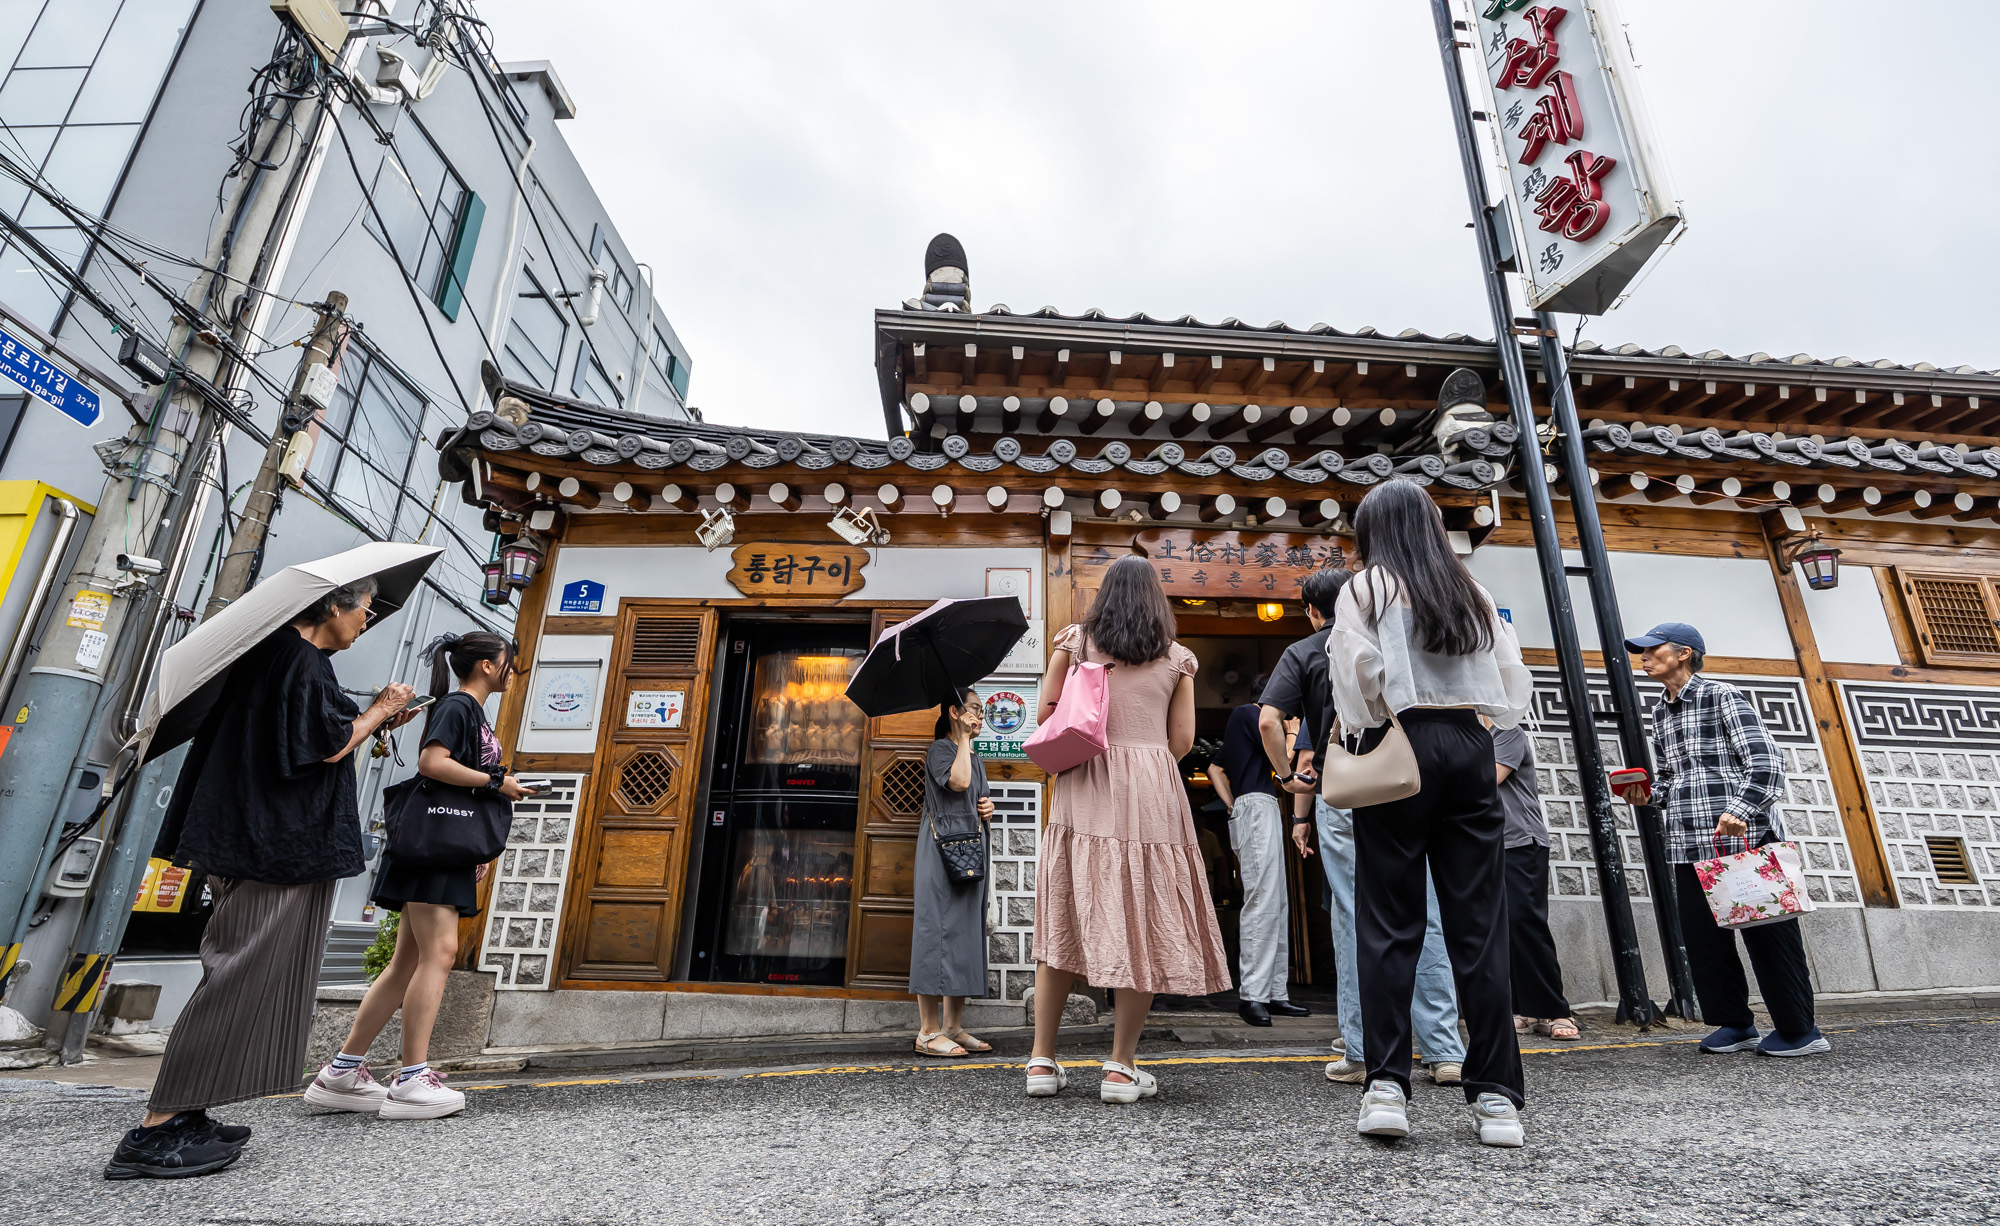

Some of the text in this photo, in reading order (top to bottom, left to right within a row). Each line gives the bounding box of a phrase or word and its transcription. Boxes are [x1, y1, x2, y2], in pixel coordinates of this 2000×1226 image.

[0, 334, 69, 394] 문로1가길
[30, 378, 65, 407] 1ga-gil
[743, 554, 851, 586] 통닭구이
[579, 585, 588, 597] 5
[993, 692, 1019, 701] 좋은식단
[427, 806, 475, 818] MOUSSY
